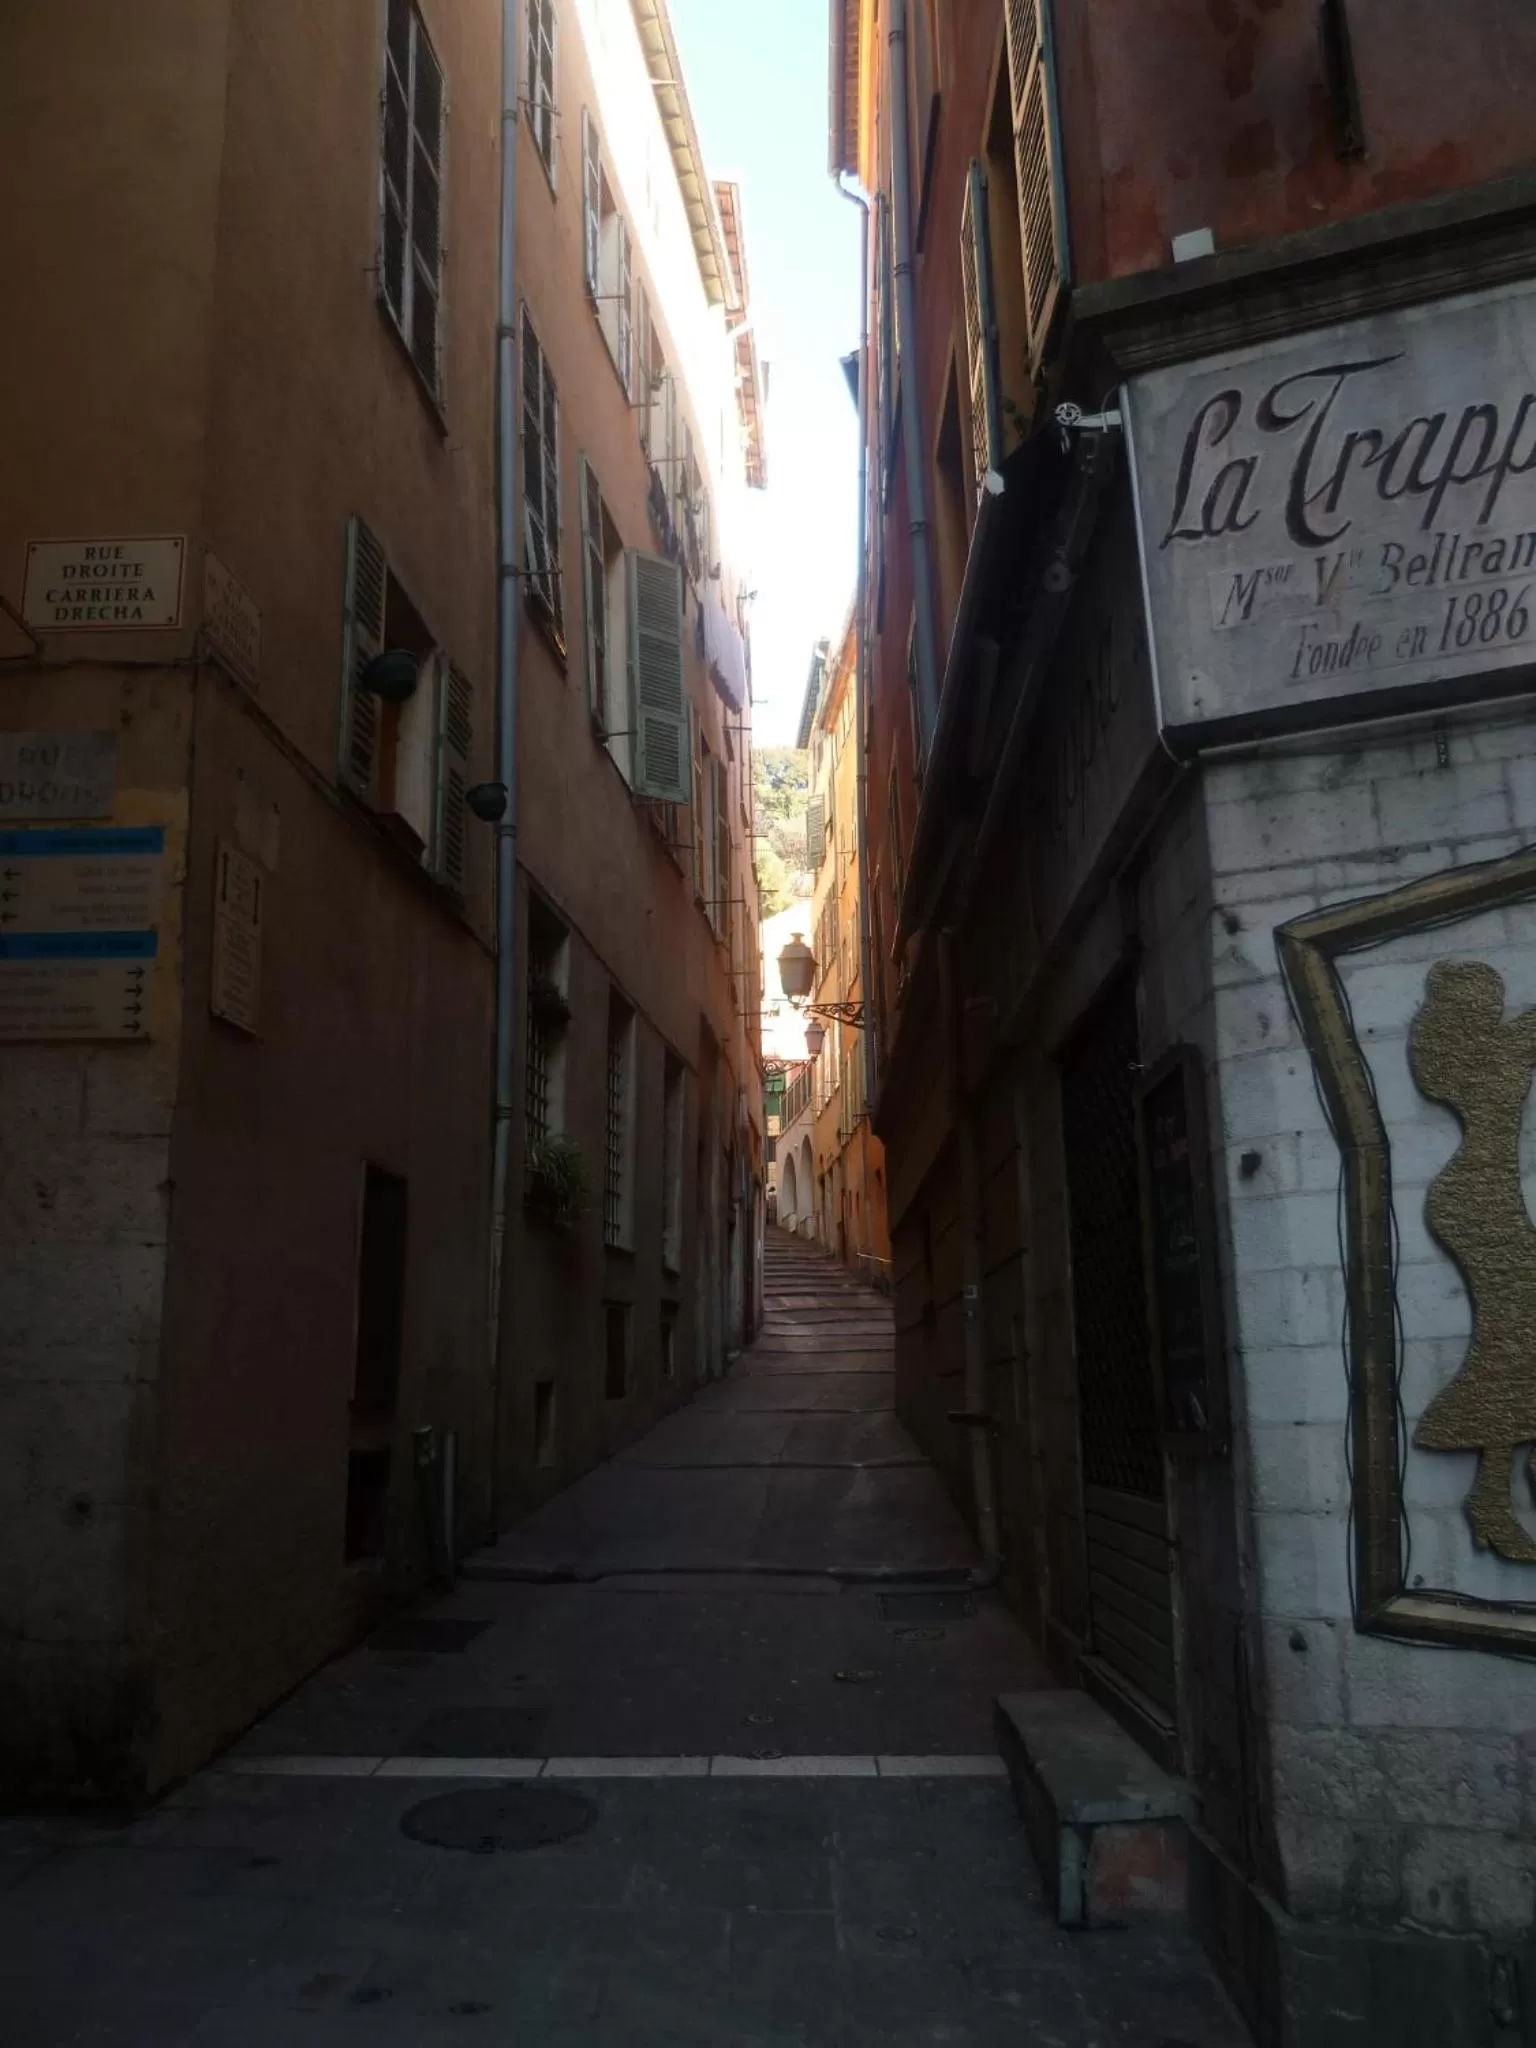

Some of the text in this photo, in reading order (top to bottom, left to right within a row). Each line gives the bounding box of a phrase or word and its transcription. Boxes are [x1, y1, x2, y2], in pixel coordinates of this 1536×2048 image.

[1158, 389, 1260, 549] La
[84, 545, 124, 561] RUE
[62, 562, 144, 579] DROITE
[54, 605, 144, 622] DRECHA
[1438, 584, 1533, 652] 1886
